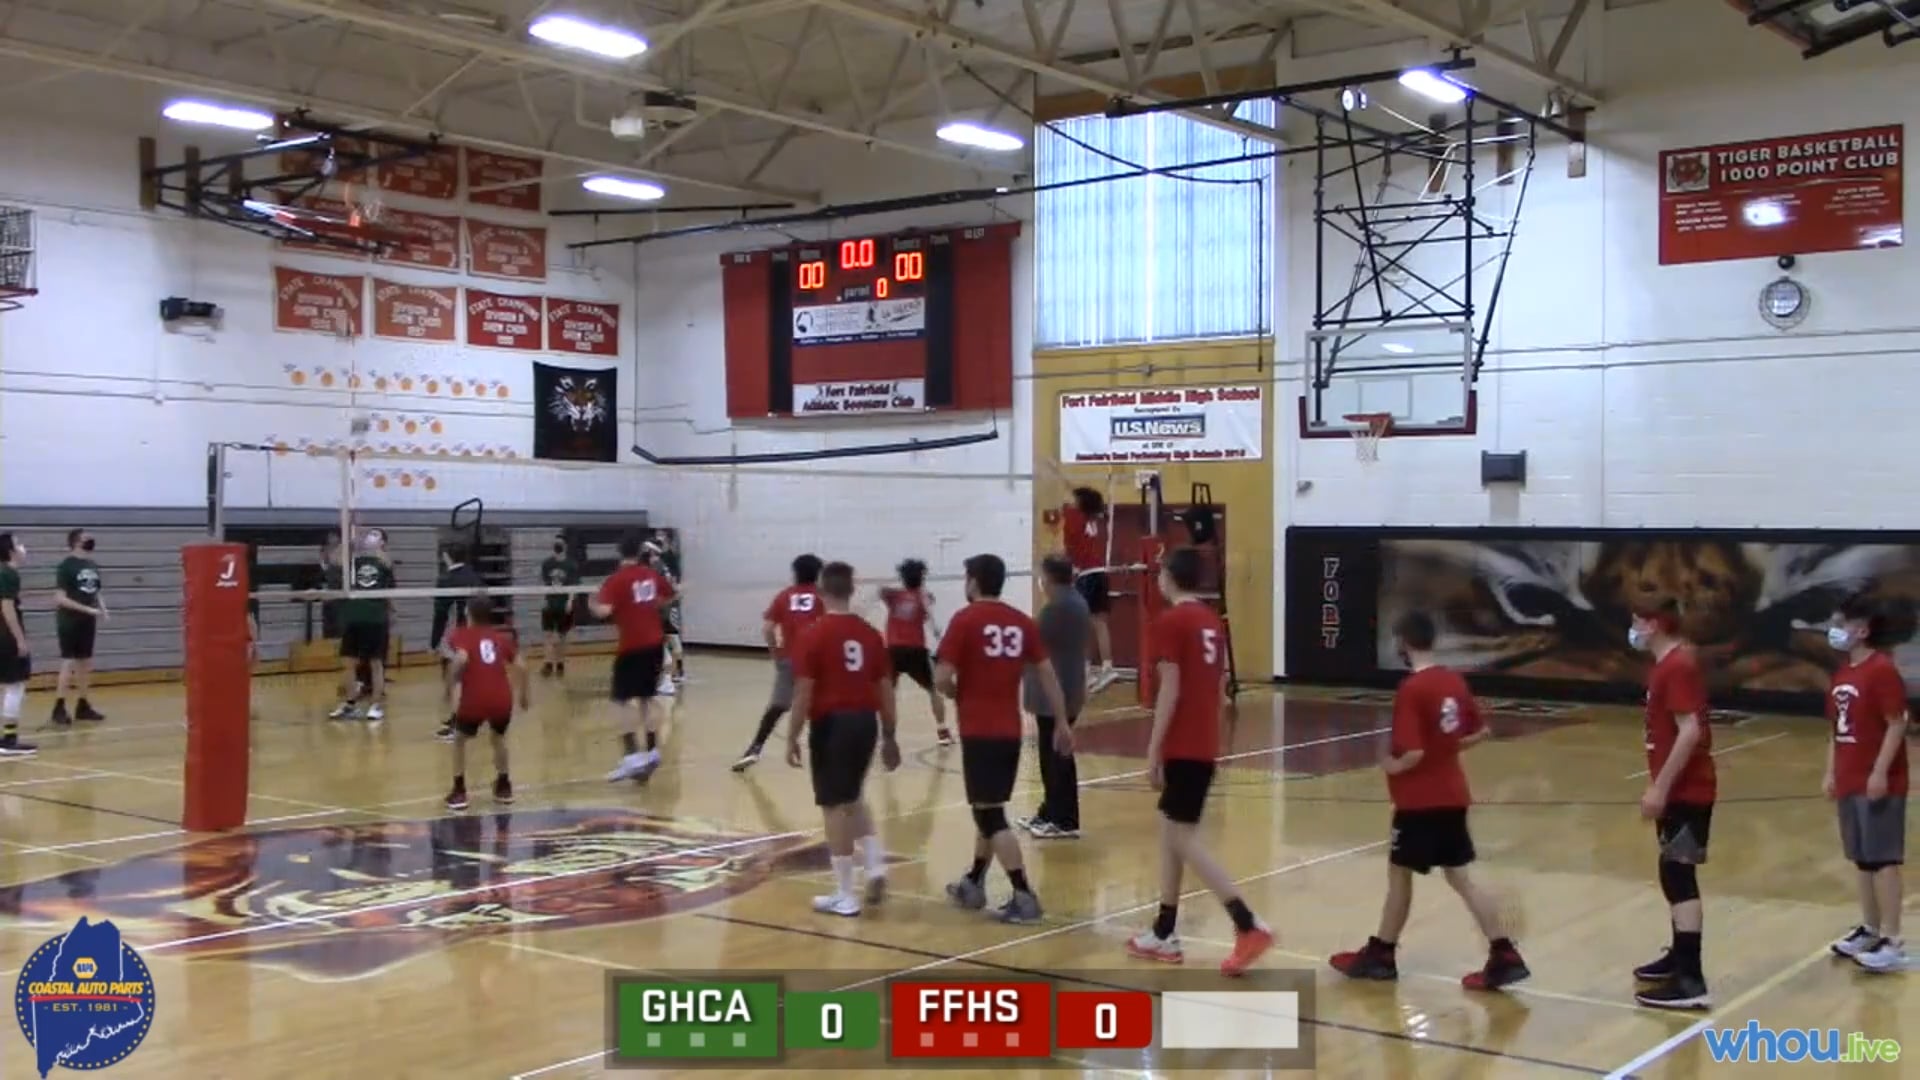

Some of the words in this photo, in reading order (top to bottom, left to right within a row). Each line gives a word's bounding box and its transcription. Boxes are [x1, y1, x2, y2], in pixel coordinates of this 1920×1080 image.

[1718, 147, 1771, 165] TIGER
[1777, 133, 1899, 159] BASKETBALL
[1720, 165, 1769, 182] 1000
[1776, 158, 1838, 177] POINT
[1845, 152, 1898, 170] CLUB
[841, 239, 873, 269] 0.0
[896, 251, 922, 280] 00
[799, 262, 824, 289] 00
[877, 277, 887, 298] 0
[825, 385, 845, 397] Fort
[849, 383, 890, 397] Fairfield
[1062, 396, 1085, 408] Fort
[1088, 393, 1136, 407] Fairfield
[1140, 391, 1181, 404] Middle
[1185, 389, 1213, 404] High
[1217, 387, 1260, 401] School
[789, 592, 815, 611] 13
[1322, 557, 1340, 649] FORT
[843, 640, 864, 671] 9
[983, 624, 1023, 657] 33
[1202, 629, 1216, 664] 5
